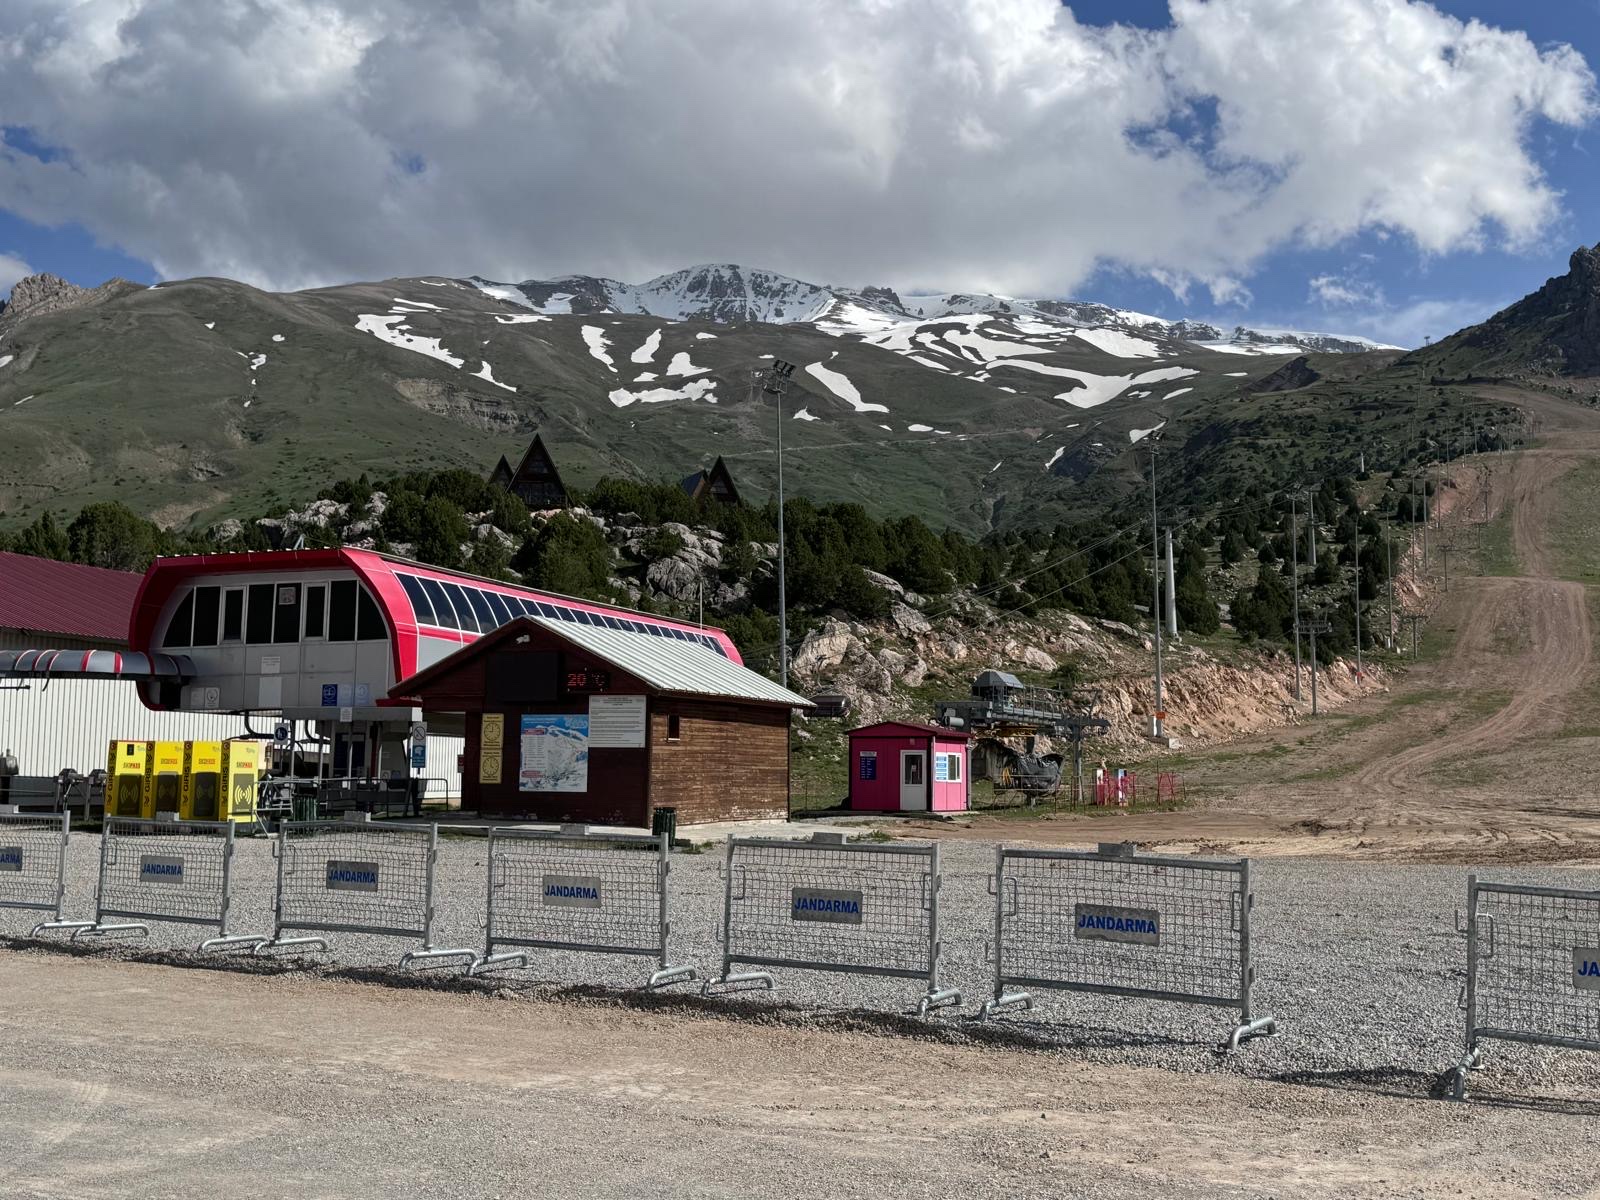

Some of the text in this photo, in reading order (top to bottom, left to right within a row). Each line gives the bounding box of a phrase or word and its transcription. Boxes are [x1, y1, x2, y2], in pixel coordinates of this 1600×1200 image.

[568, 674, 586, 686] 20
[142, 864, 182, 876] JANDARMA
[328, 870, 376, 883] JANDARMA
[545, 884, 598, 900] JANDARMA
[794, 898, 859, 914] JANDARMA
[1078, 914, 1157, 934] JANDARMA
